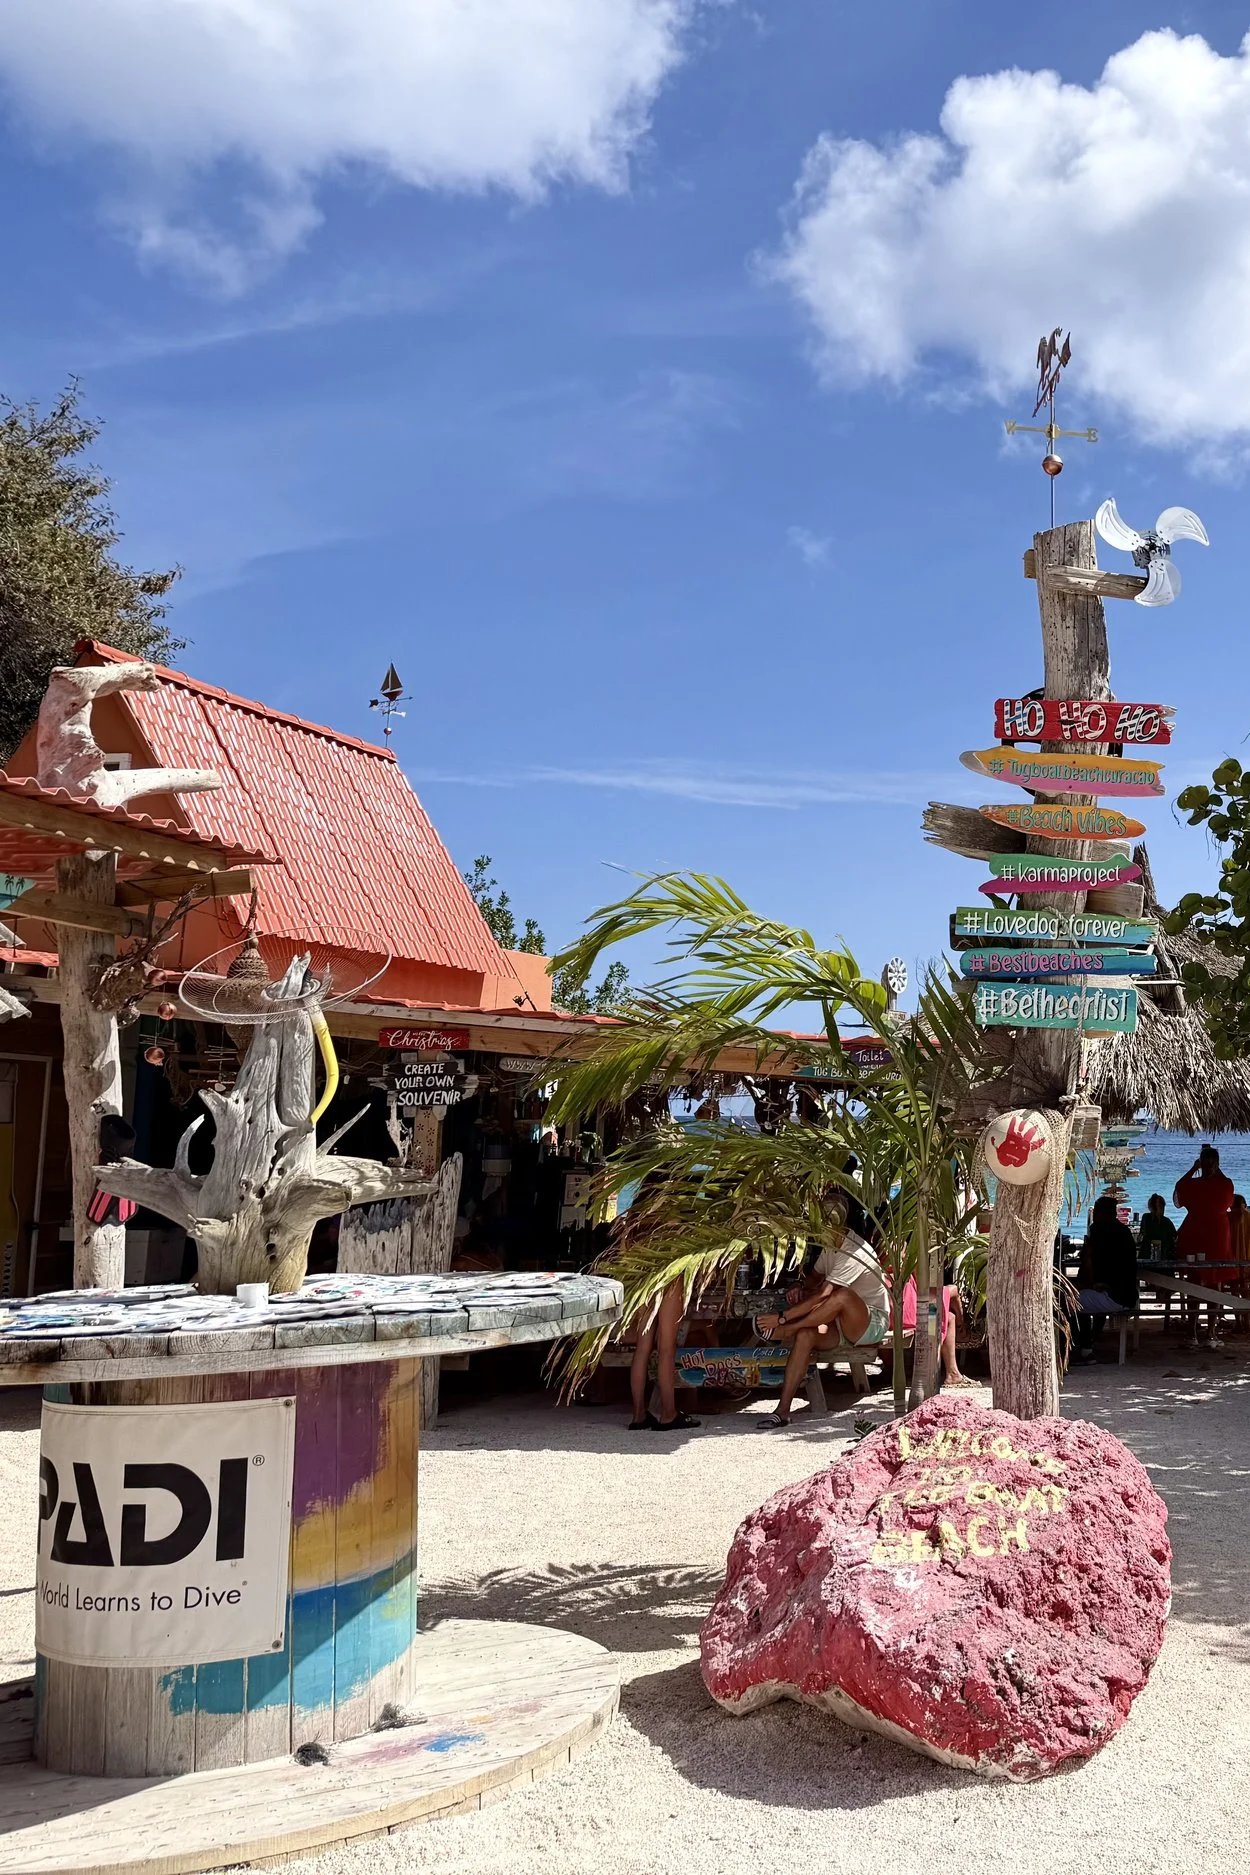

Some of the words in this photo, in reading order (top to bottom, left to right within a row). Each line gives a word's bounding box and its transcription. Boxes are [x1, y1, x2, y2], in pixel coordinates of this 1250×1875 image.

[1003, 699, 1045, 737] HO
[1058, 701, 1107, 740] HO
[1114, 705, 1161, 742] HO
[1006, 805, 1073, 832] #Beach
[389, 1030, 457, 1050] Christmas
[856, 1049, 884, 1062] Toilet
[405, 1063, 445, 1075] CREATE
[812, 1066, 828, 1077] TUG
[395, 1076, 423, 1089] YOUR
[425, 1075, 455, 1087] OWN
[397, 1089, 461, 1106] SOUVENIR
[681, 1349, 705, 1369] HOT
[75, 1587, 141, 1612] Learns
[150, 1591, 173, 1611] to
[183, 1585, 242, 1609] Dive
